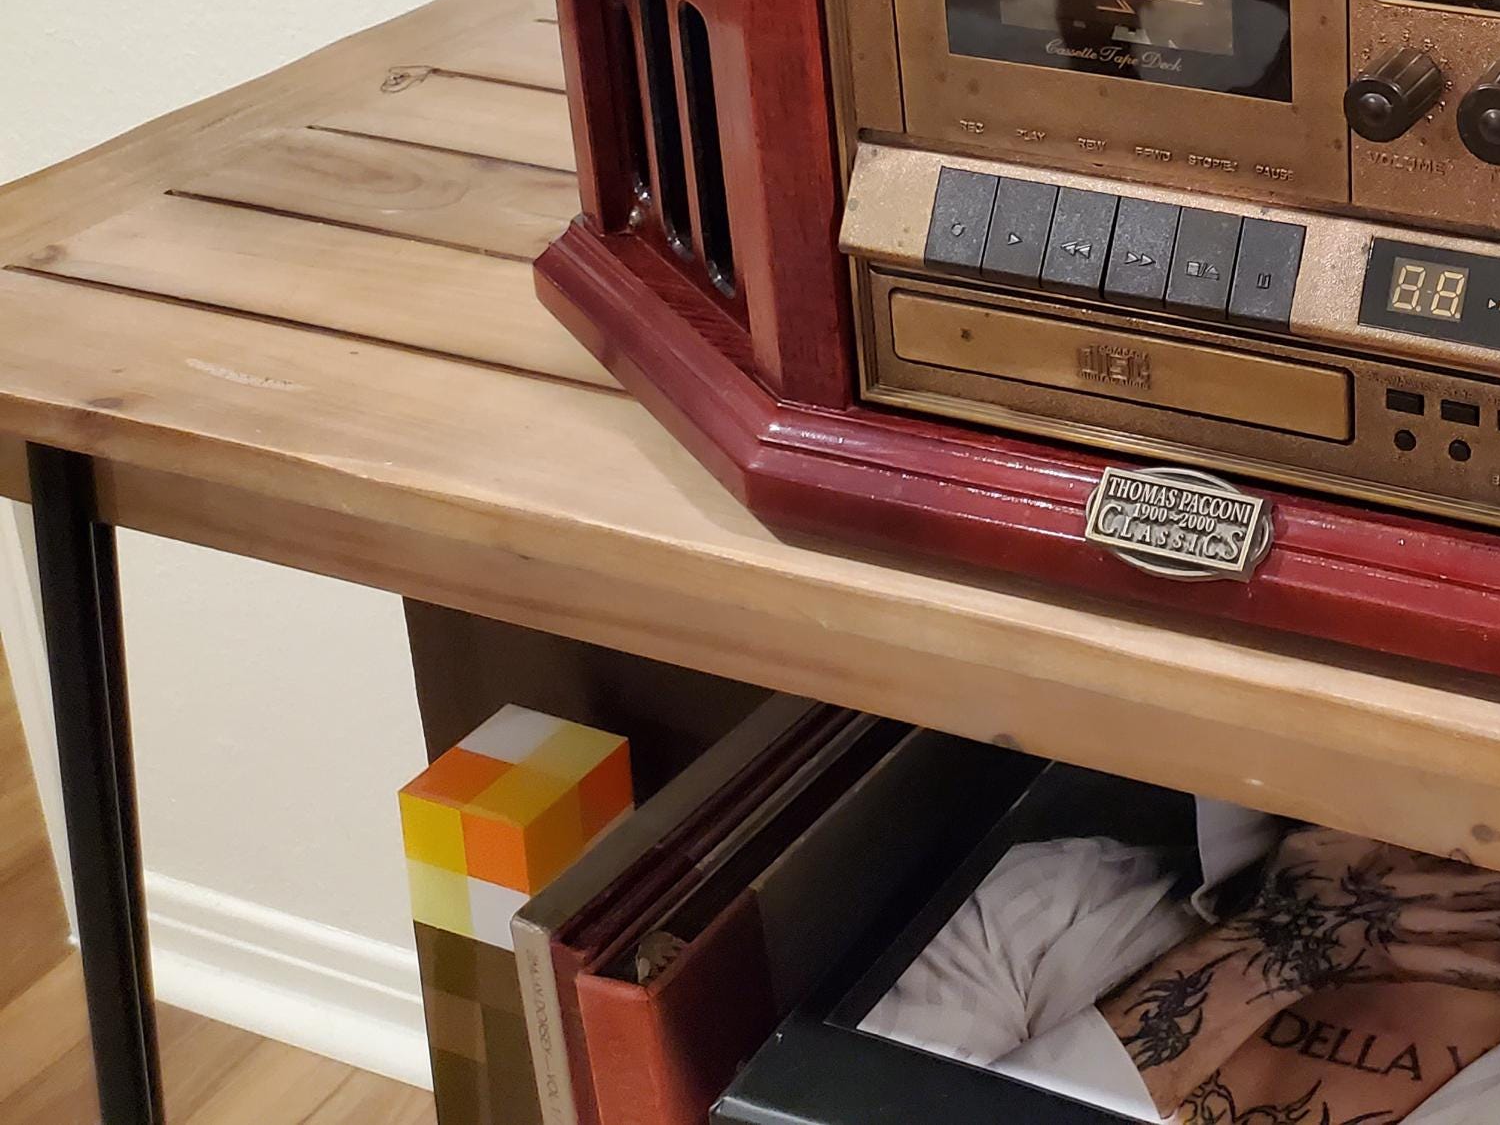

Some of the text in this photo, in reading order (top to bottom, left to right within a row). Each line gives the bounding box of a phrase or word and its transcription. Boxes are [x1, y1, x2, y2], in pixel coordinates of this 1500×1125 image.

[1045, 38, 1183, 72] Cassette Tape Deck
[1255, 164, 1295, 182] PAUSE
[1107, 476, 1254, 524] THOMAS PACCONI
[1097, 502, 1244, 560] CLASSICS
[1260, 1007, 1424, 1082] DELLA
